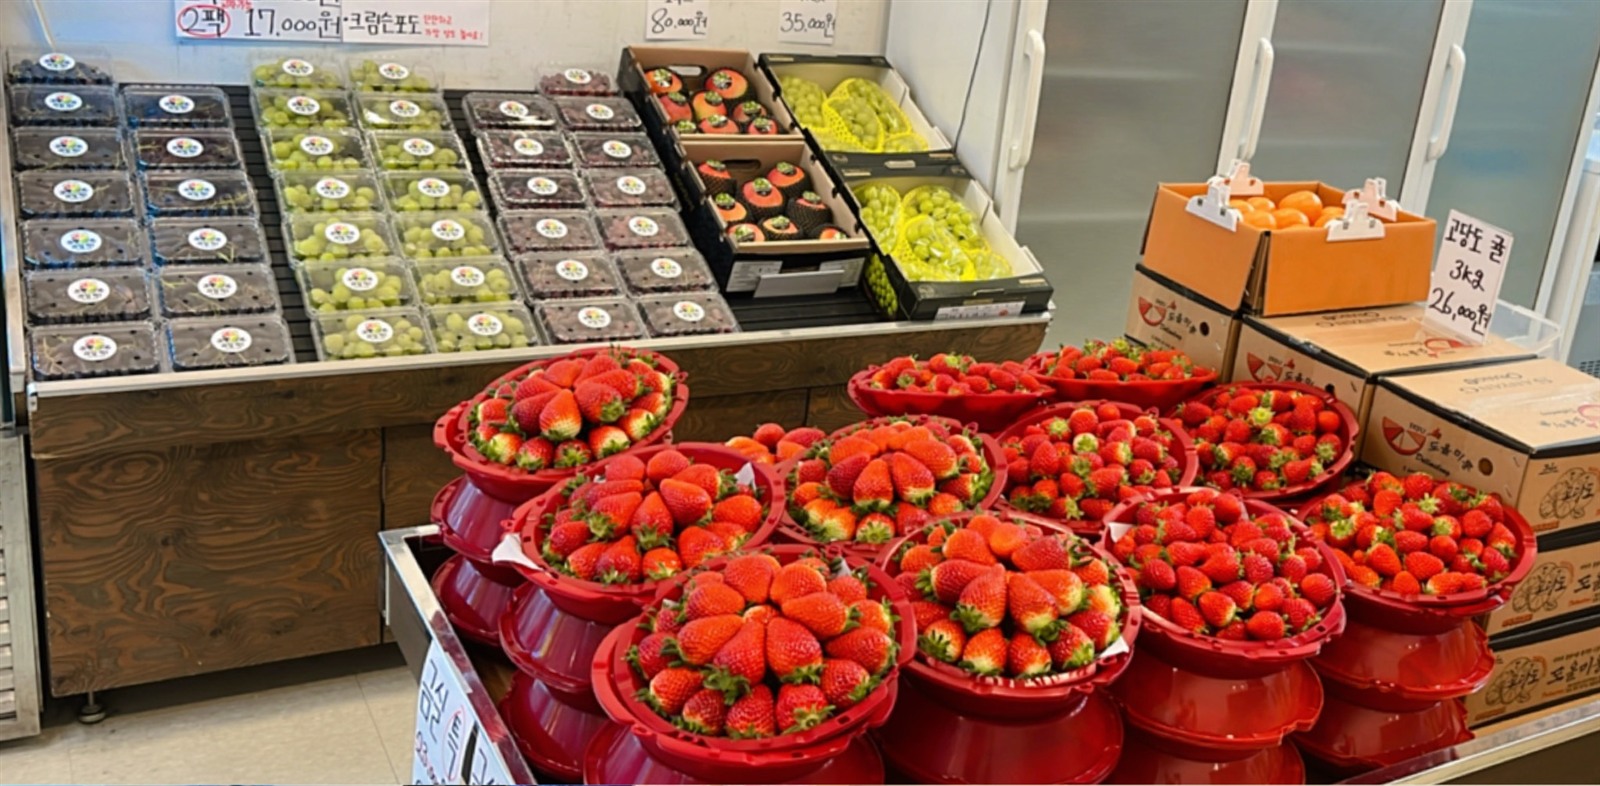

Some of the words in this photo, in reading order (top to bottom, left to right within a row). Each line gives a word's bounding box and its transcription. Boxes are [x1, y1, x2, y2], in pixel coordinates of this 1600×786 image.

[181, 7, 226, 37] 2팩
[1445, 218, 1484, 254] 고당도
[1449, 259, 1486, 292] 3kg
